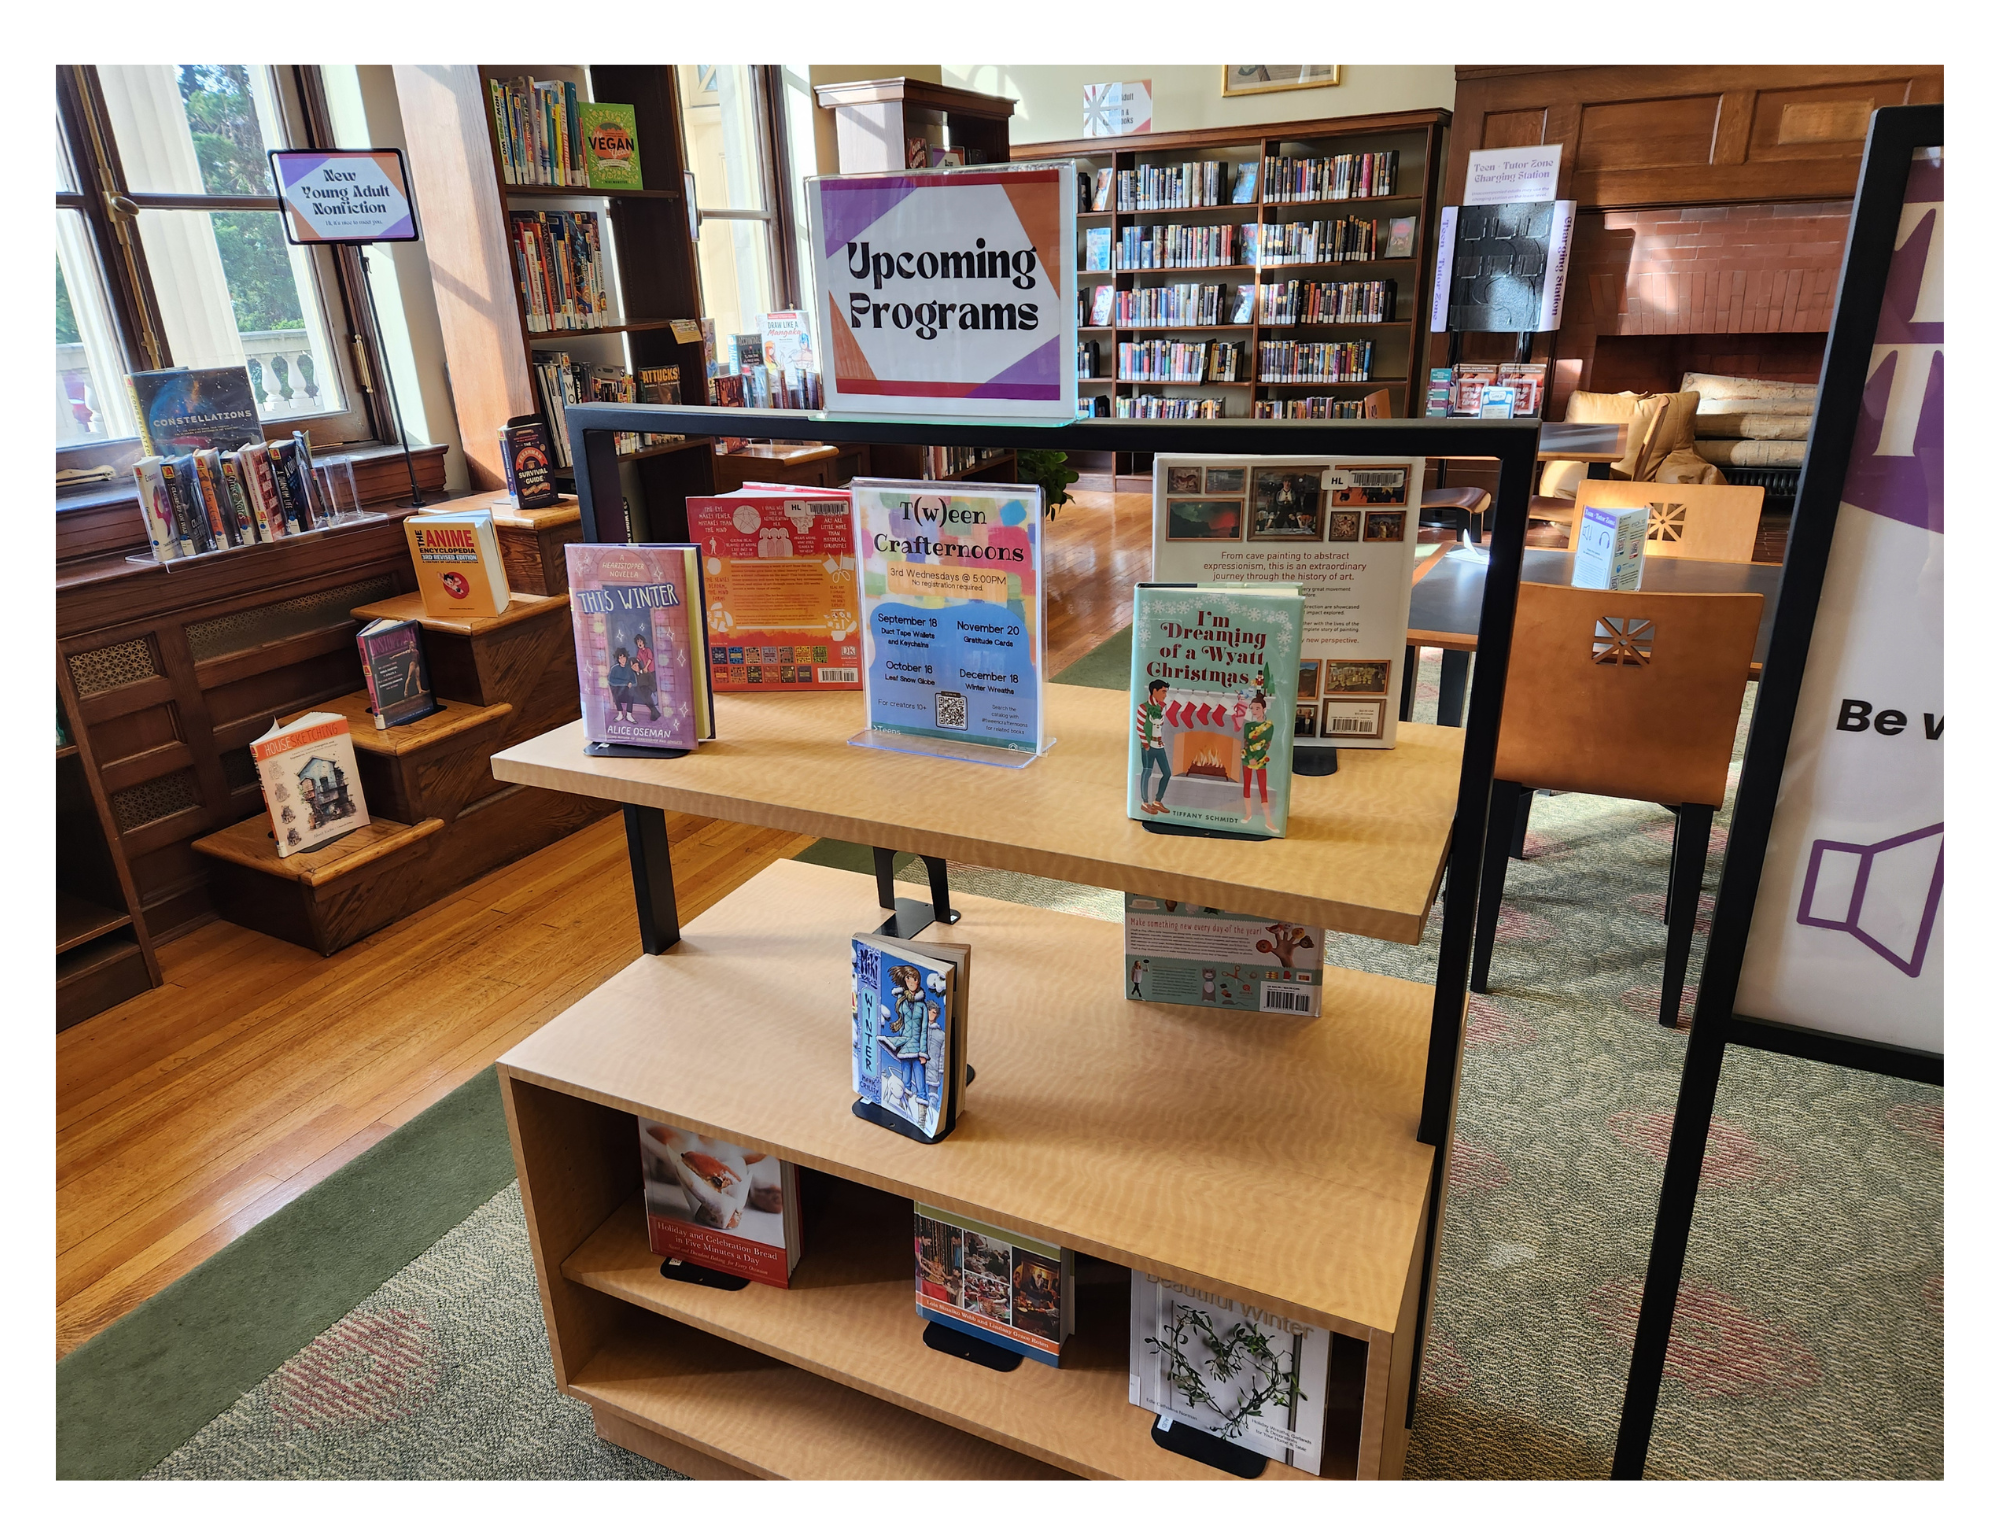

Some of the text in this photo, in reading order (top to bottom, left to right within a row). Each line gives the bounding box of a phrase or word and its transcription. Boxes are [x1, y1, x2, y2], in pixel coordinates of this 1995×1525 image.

[588, 136, 635, 150] VEGAN
[1474, 159, 1554, 172] Teen Tutor Zone
[323, 169, 356, 182] New
[1474, 170, 1550, 183] Charging Station
[301, 184, 390, 202] Young Adult
[312, 201, 386, 215] Nonfiction
[847, 238, 1037, 290] Upcoming
[1432, 220, 1449, 320] Teen Tutor Zone
[1552, 216, 1572, 316] Charging Station
[850, 292, 1038, 340] Programs
[153, 410, 252, 428] CONSTELLATIONS
[518, 468, 548, 479] SURVIVAL
[525, 476, 544, 485] GUIDE
[1331, 477, 1344, 485] HL
[900, 496, 987, 527] T(w)een
[415, 530, 474, 547] THE ANIME
[874, 533, 1024, 562] Crafternoons
[1267, 552, 1301, 561] painting
[602, 562, 644, 570] HEARTSTOPPER
[1203, 562, 1266, 571] expressionism,
[1268, 562, 1285, 570] this
[1286, 562, 1294, 570] is
[1309, 562, 1367, 571] extraordinary
[609, 570, 639, 578] NOVELLA
[890, 568, 904, 577] 3rd
[906, 569, 960, 582] Wednesdays
[973, 574, 1007, 585] 5:00PM
[1213, 573, 1244, 581] journey
[1246, 573, 1279, 582] through
[1300, 573, 1327, 582] history
[921, 581, 955, 589] registration
[956, 583, 983, 592] required.
[577, 584, 679, 613] THIS WINTER
[878, 613, 938, 627] September 18
[1197, 610, 1229, 628] I'm
[896, 629, 911, 637] Tape
[913, 631, 935, 639] Wallets
[957, 620, 1020, 635] November 20
[964, 636, 1014, 647] Gratitude Cards
[1160, 622, 1266, 650] Dreaming
[900, 640, 929, 648] Keychains
[1160, 644, 1264, 666] of a Wyatt
[886, 660, 933, 674] October 18
[1146, 661, 1249, 688] Christmas
[960, 669, 1019, 684] December 18
[965, 683, 1014, 695] Winter Wreaths
[890, 702, 915, 710] creators
[1836, 698, 1908, 736] Be
[264, 737, 291, 756] HOUSE
[290, 724, 338, 747] SKETCHING
[607, 726, 672, 739] ALICE OSEMAN
[1172, 810, 1239, 824] TIFFANY SCHMIDT
[1130, 918, 1146, 927] Make
[1147, 919, 1178, 931] something
[1194, 924, 1210, 933] every
[1213, 924, 1224, 933] day
[1234, 926, 1245, 934] the
[1246, 927, 1262, 936] year!
[860, 949, 878, 982] Miki
[864, 992, 874, 1072] WINTER
[861, 1076, 876, 1086] MARK
[658, 1222, 778, 1260] Holiday and Celebration Bread
[685, 1238, 701, 1248] Five
[704, 1242, 734, 1258] Minutes
[744, 1254, 760, 1266] Day
[927, 1300, 939, 1309] Lois
[962, 1311, 976, 1322] Webb
[978, 1317, 988, 1326] and
[989, 1321, 1012, 1335] Lindsay
[1013, 1330, 1030, 1340] Grace
[1239, 1301, 1314, 1339] Winter
